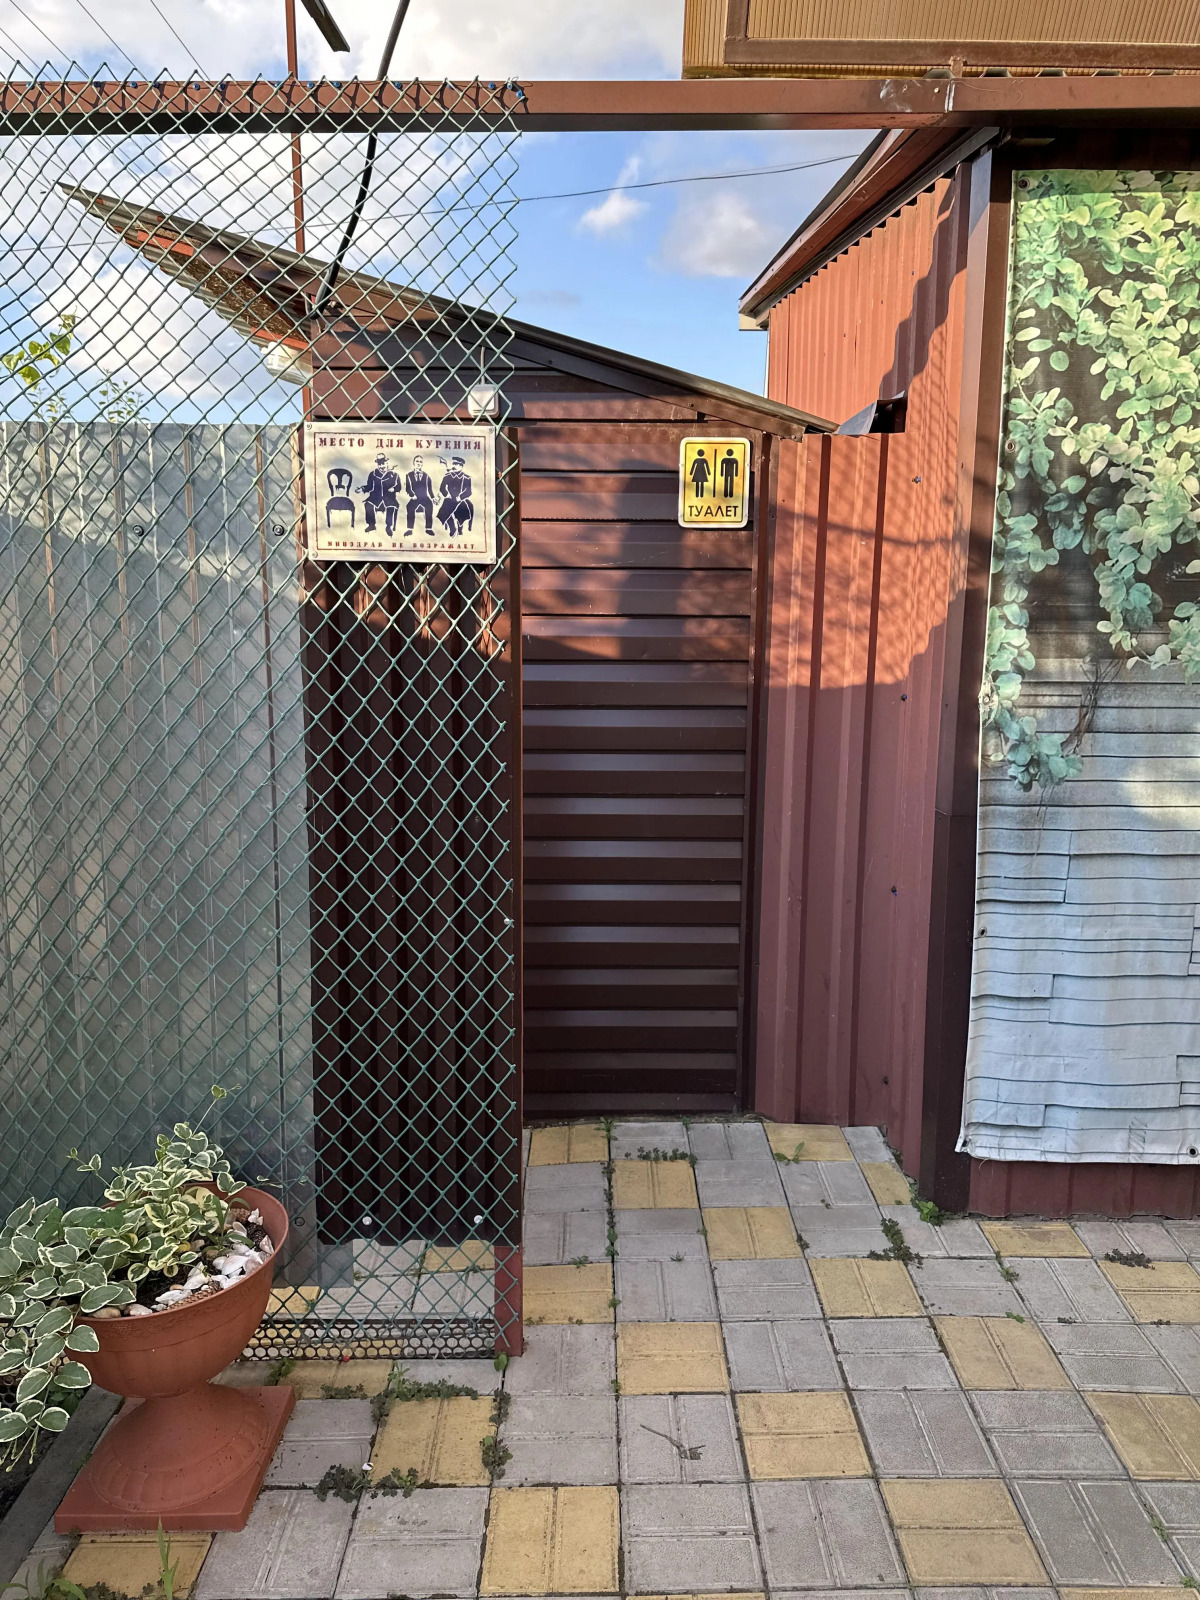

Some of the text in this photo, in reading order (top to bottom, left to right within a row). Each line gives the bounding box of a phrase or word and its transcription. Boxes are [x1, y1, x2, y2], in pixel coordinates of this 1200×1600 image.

[319, 437, 482, 450] МЕСТО ДЛЯ КУРЕНИЯ
[688, 505, 739, 517] ТУАЛЕТ
